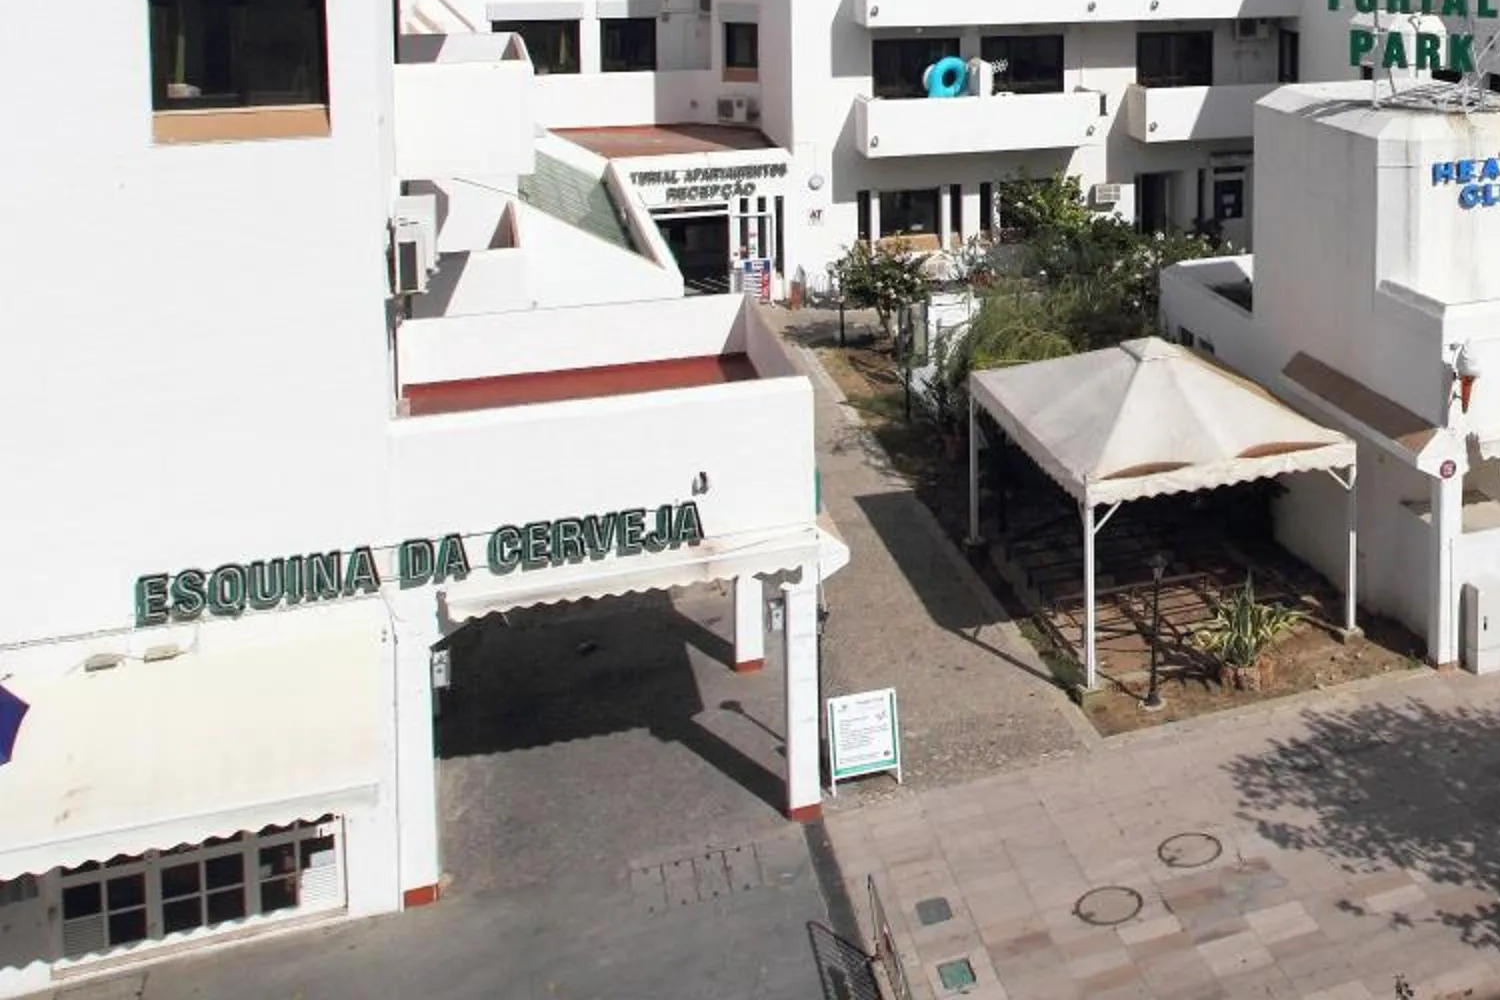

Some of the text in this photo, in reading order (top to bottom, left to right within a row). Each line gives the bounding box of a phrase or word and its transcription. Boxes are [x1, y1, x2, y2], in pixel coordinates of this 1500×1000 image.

[1350, 29, 1475, 73] PARK
[133, 501, 706, 627] ESQUINA DA CERVEJA
